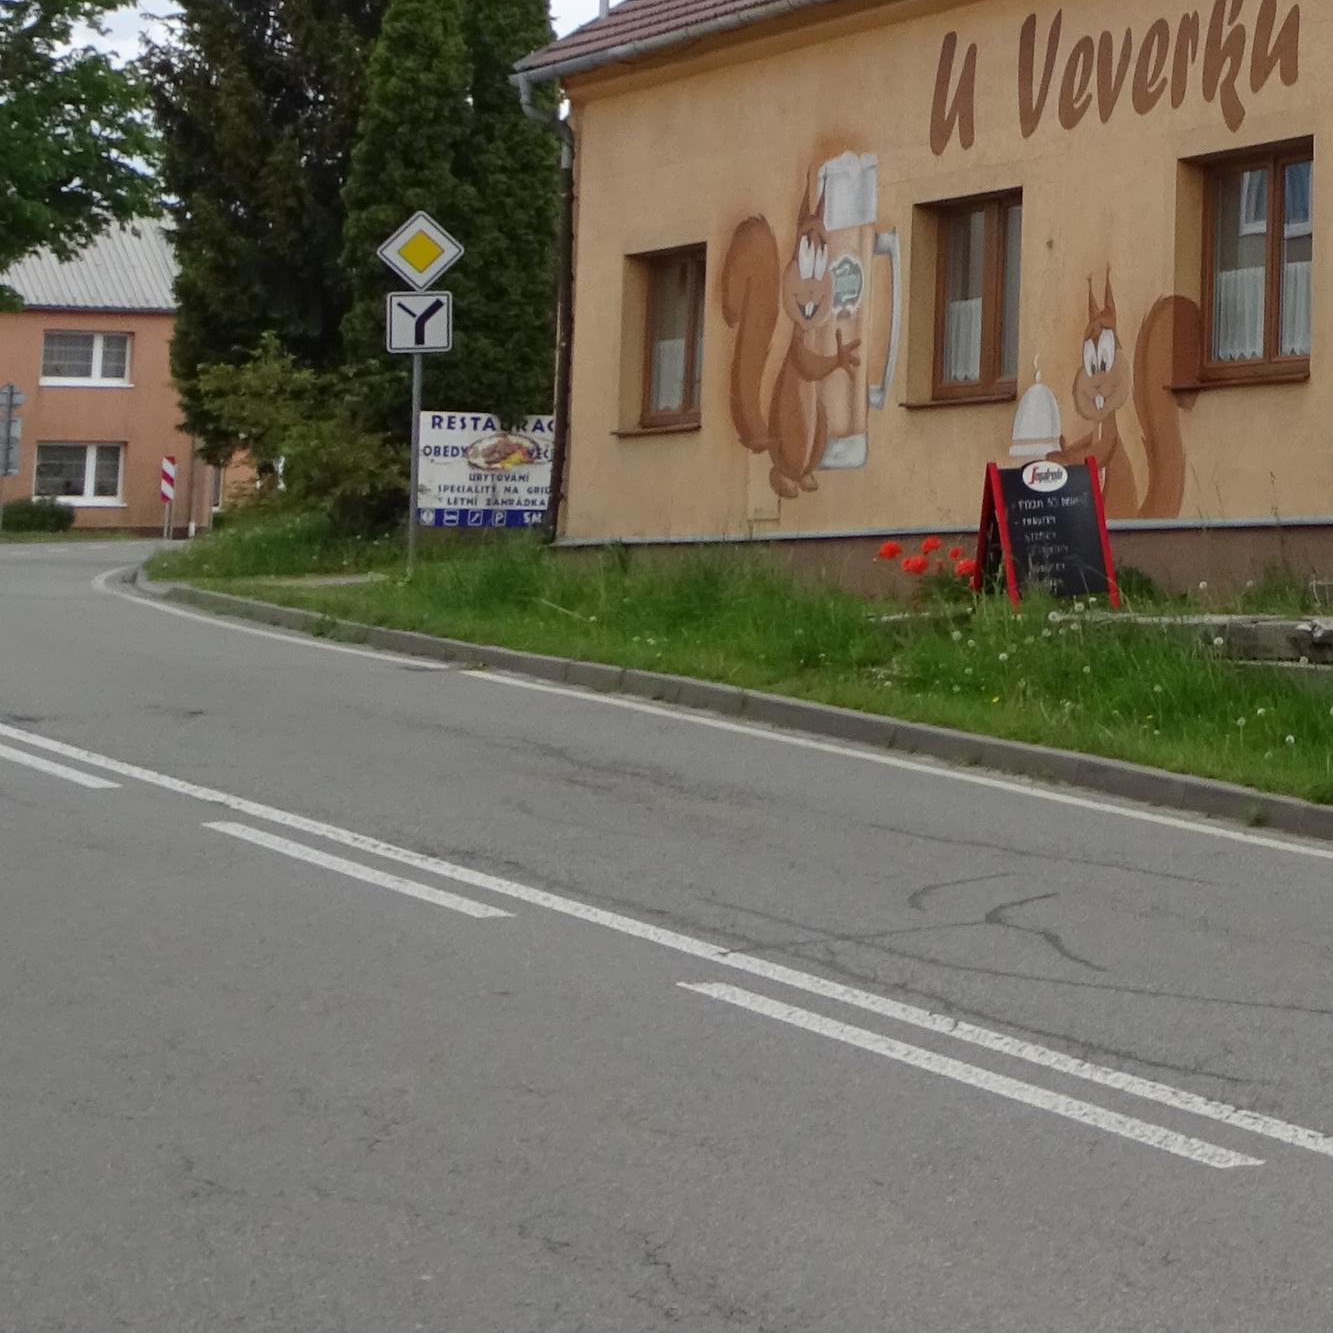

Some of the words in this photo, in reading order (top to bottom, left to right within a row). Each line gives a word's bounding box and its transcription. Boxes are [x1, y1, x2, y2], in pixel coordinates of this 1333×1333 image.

[929, 31, 978, 157] U
[438, 484, 497, 494] SPECIALITY
[504, 486, 519, 495] NA
[447, 496, 478, 506] LETNÍ
